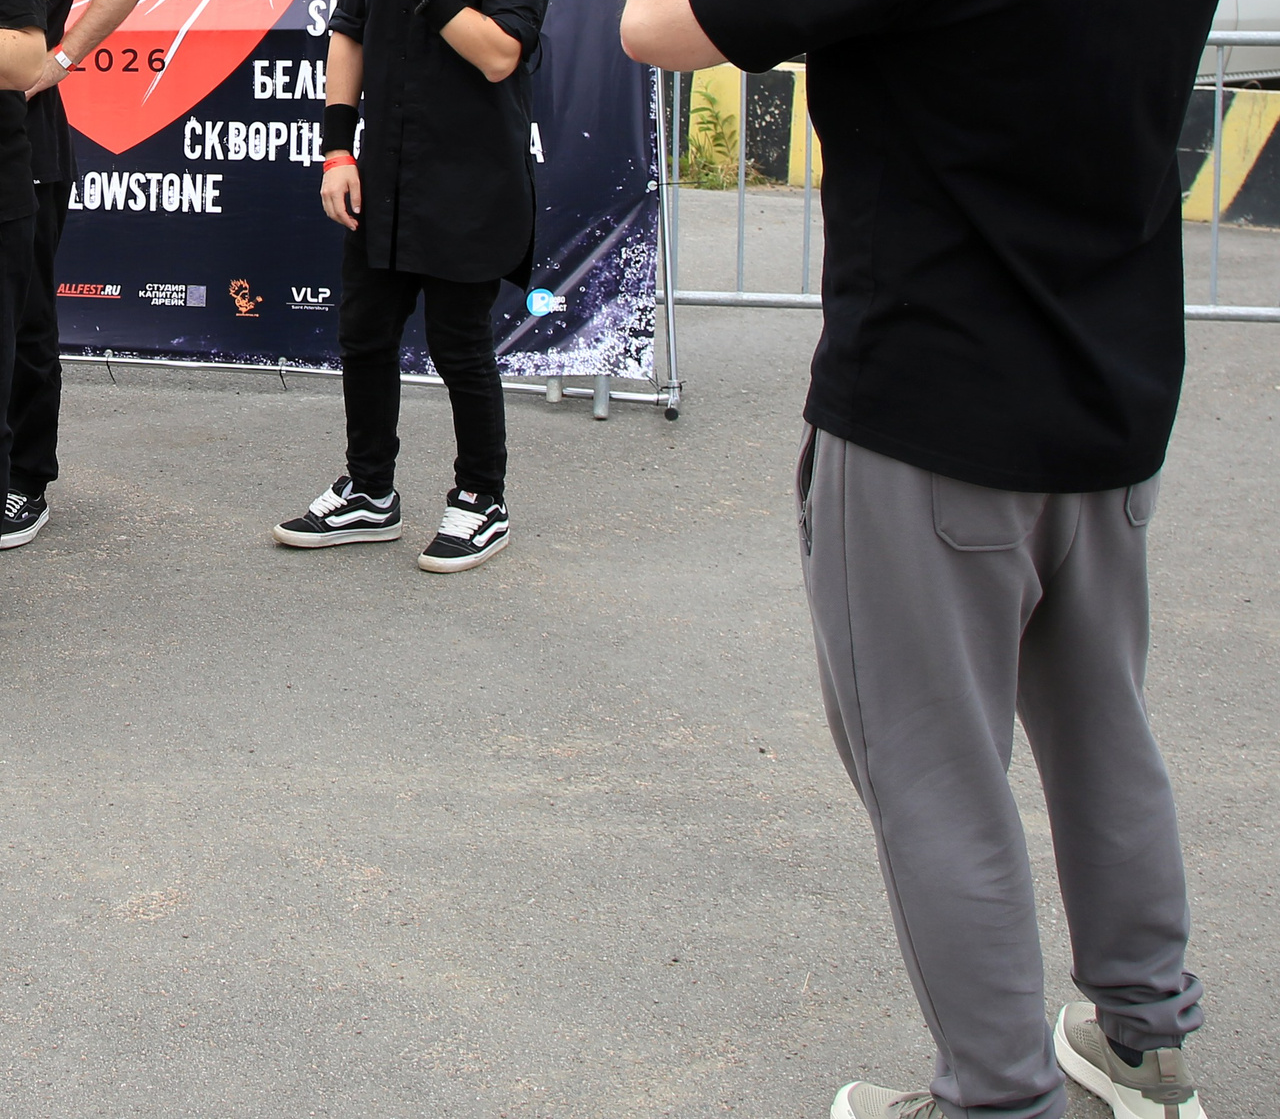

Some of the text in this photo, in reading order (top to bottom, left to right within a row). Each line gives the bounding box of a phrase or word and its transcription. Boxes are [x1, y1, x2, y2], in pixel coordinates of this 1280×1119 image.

[72, 48, 166, 73] 026
[145, 283, 186, 292] СТУДИЯ
[138, 290, 186, 299] КАПИТАН
[291, 286, 331, 303] VLP
[150, 298, 185, 307] ДРЕЙК
